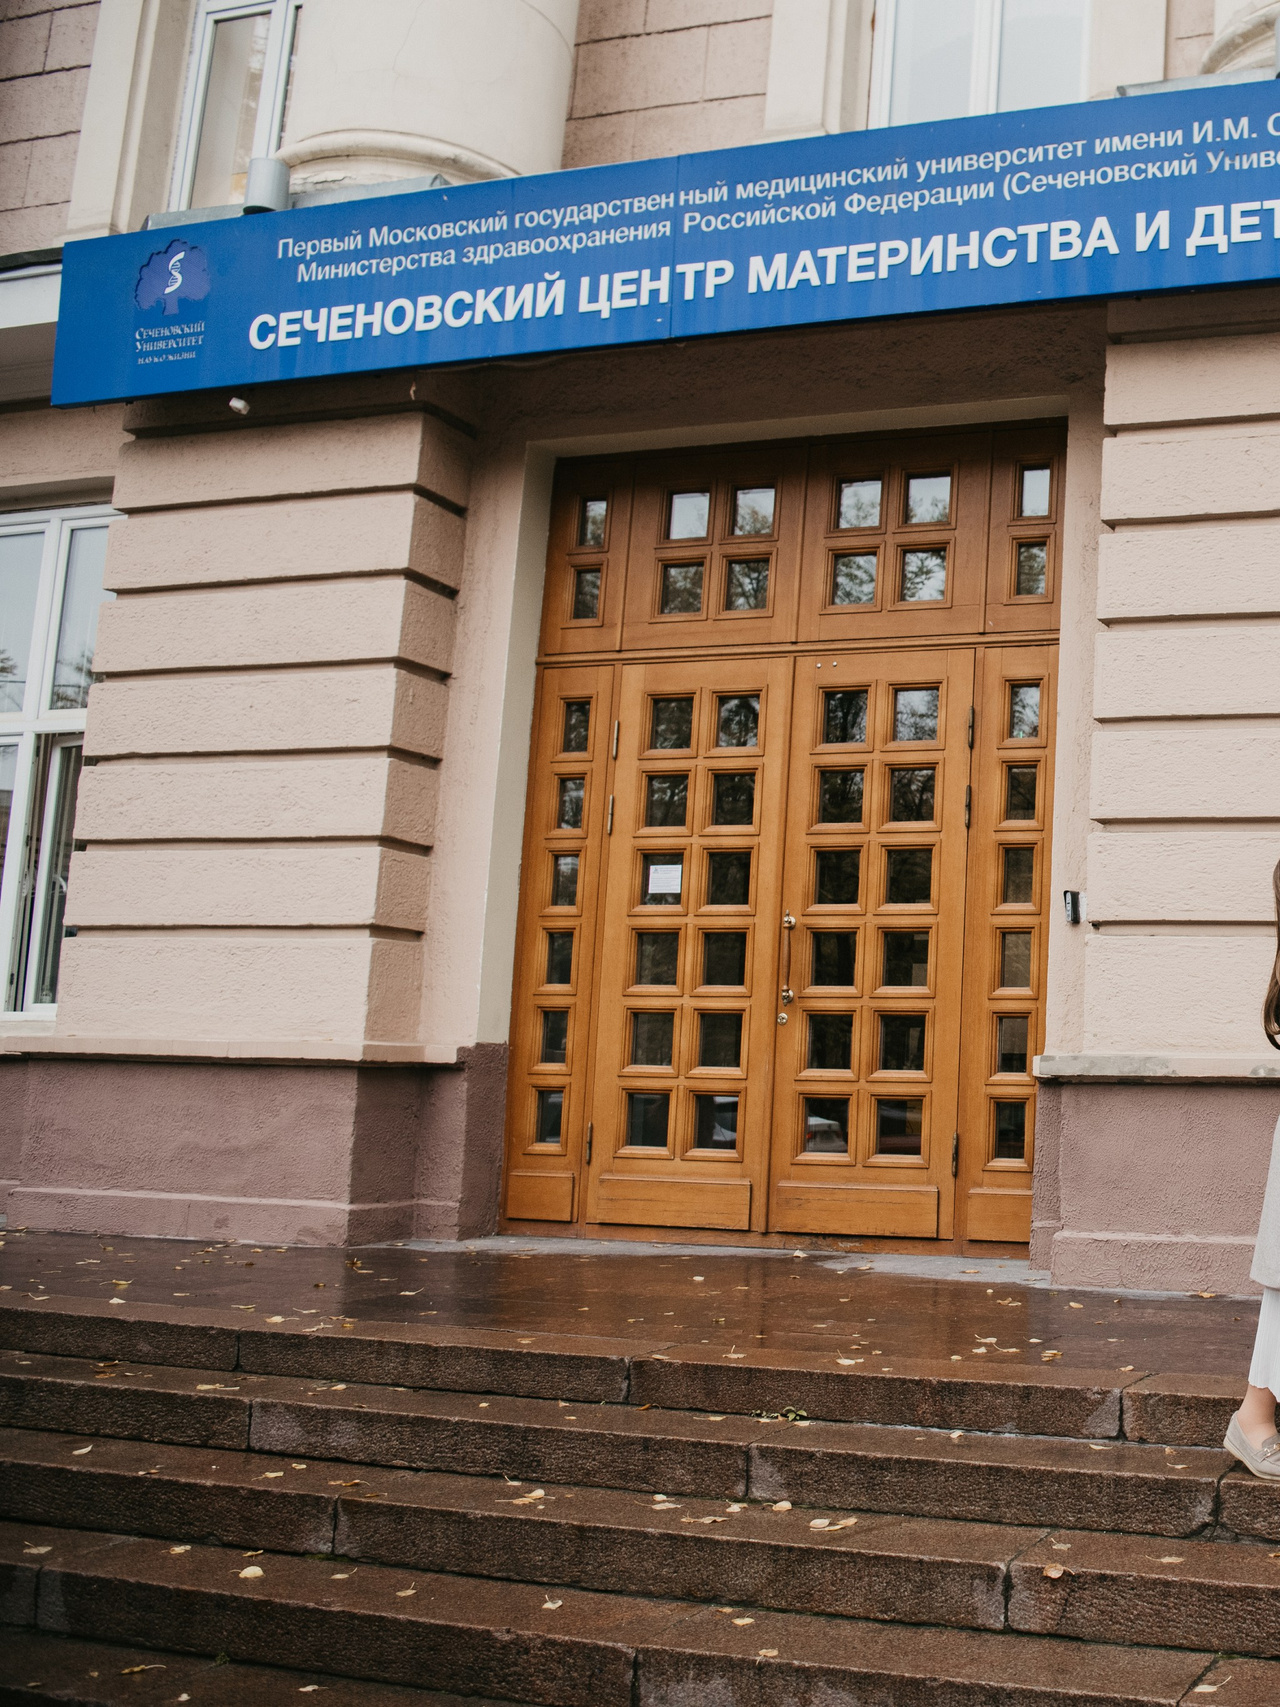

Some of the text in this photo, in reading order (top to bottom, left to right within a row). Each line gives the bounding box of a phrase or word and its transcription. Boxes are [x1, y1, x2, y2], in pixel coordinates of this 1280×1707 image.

[277, 229, 361, 259] Первый
[369, 211, 508, 247] Московский
[515, 181, 728, 230] государственный
[736, 158, 908, 204] медицинский
[916, 140, 1088, 183] университет
[1095, 128, 1184, 154] имени
[1193, 116, 1258, 145] И.М.
[297, 249, 456, 283] Министерства
[462, 221, 671, 266] здравоохранения
[684, 196, 837, 234] Российской
[844, 181, 995, 216] Федерации
[1003, 153, 1198, 201] (Сеченовский
[248, 271, 566, 350] СЕЧЕНОВСКИЙ
[578, 260, 735, 319] ЦЕНТР
[747, 217, 1120, 294] МАТЕРИНСТВА
[1136, 209, 1170, 252] И
